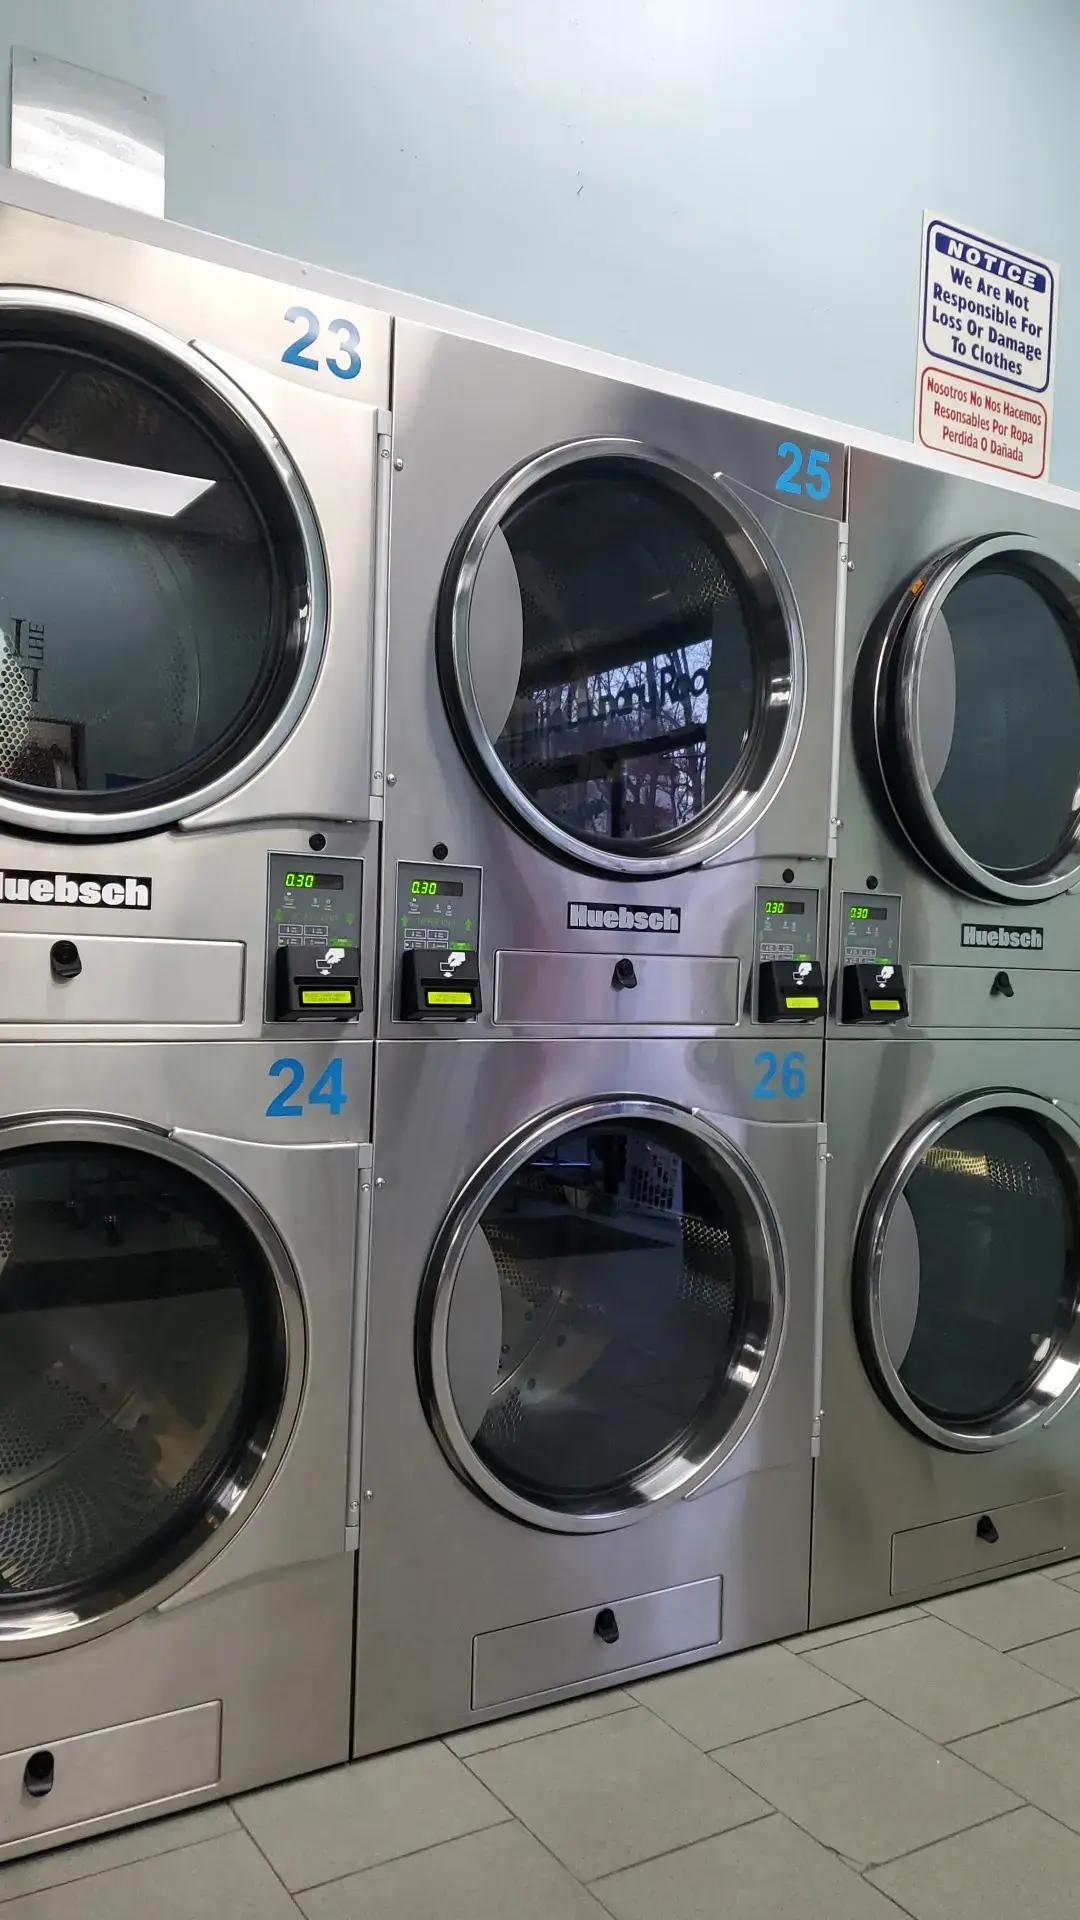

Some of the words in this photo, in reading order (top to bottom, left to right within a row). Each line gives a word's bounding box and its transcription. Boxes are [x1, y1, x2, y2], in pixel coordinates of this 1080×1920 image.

[947, 240, 1037, 289] NOTICE
[950, 265, 972, 289] We
[977, 277, 1000, 300] Are
[1005, 287, 1029, 312] Not
[932, 305, 962, 331] Loss
[967, 319, 983, 338] Or
[988, 326, 1042, 361] Damage
[933, 282, 1017, 329] Responsible
[1021, 316, 1042, 338] For
[281, 306, 361, 380] 23
[951, 336, 966, 355] To
[971, 343, 1022, 375] Clothes
[927, 377, 968, 402] Nosotros
[970, 391, 982, 407] No
[985, 395, 1000, 413] Nos
[1003, 401, 1042, 426] Hacemos
[934, 401, 990, 431] Resonsables
[992, 419, 1008, 436] Por
[1010, 425, 1033, 445] Ropa
[942, 425, 978, 449] Perdida
[981, 437, 988, 451] O
[990, 440, 1023, 461] Dañada
[776, 442, 830, 500] 25
[285, 873, 314, 888] 0.30
[411, 881, 437, 895] 0.30
[570, 904, 679, 931] Huebsch
[963, 925, 1042, 948] Huebsch
[265, 1057, 348, 1116] 24
[752, 1050, 806, 1099] 26
